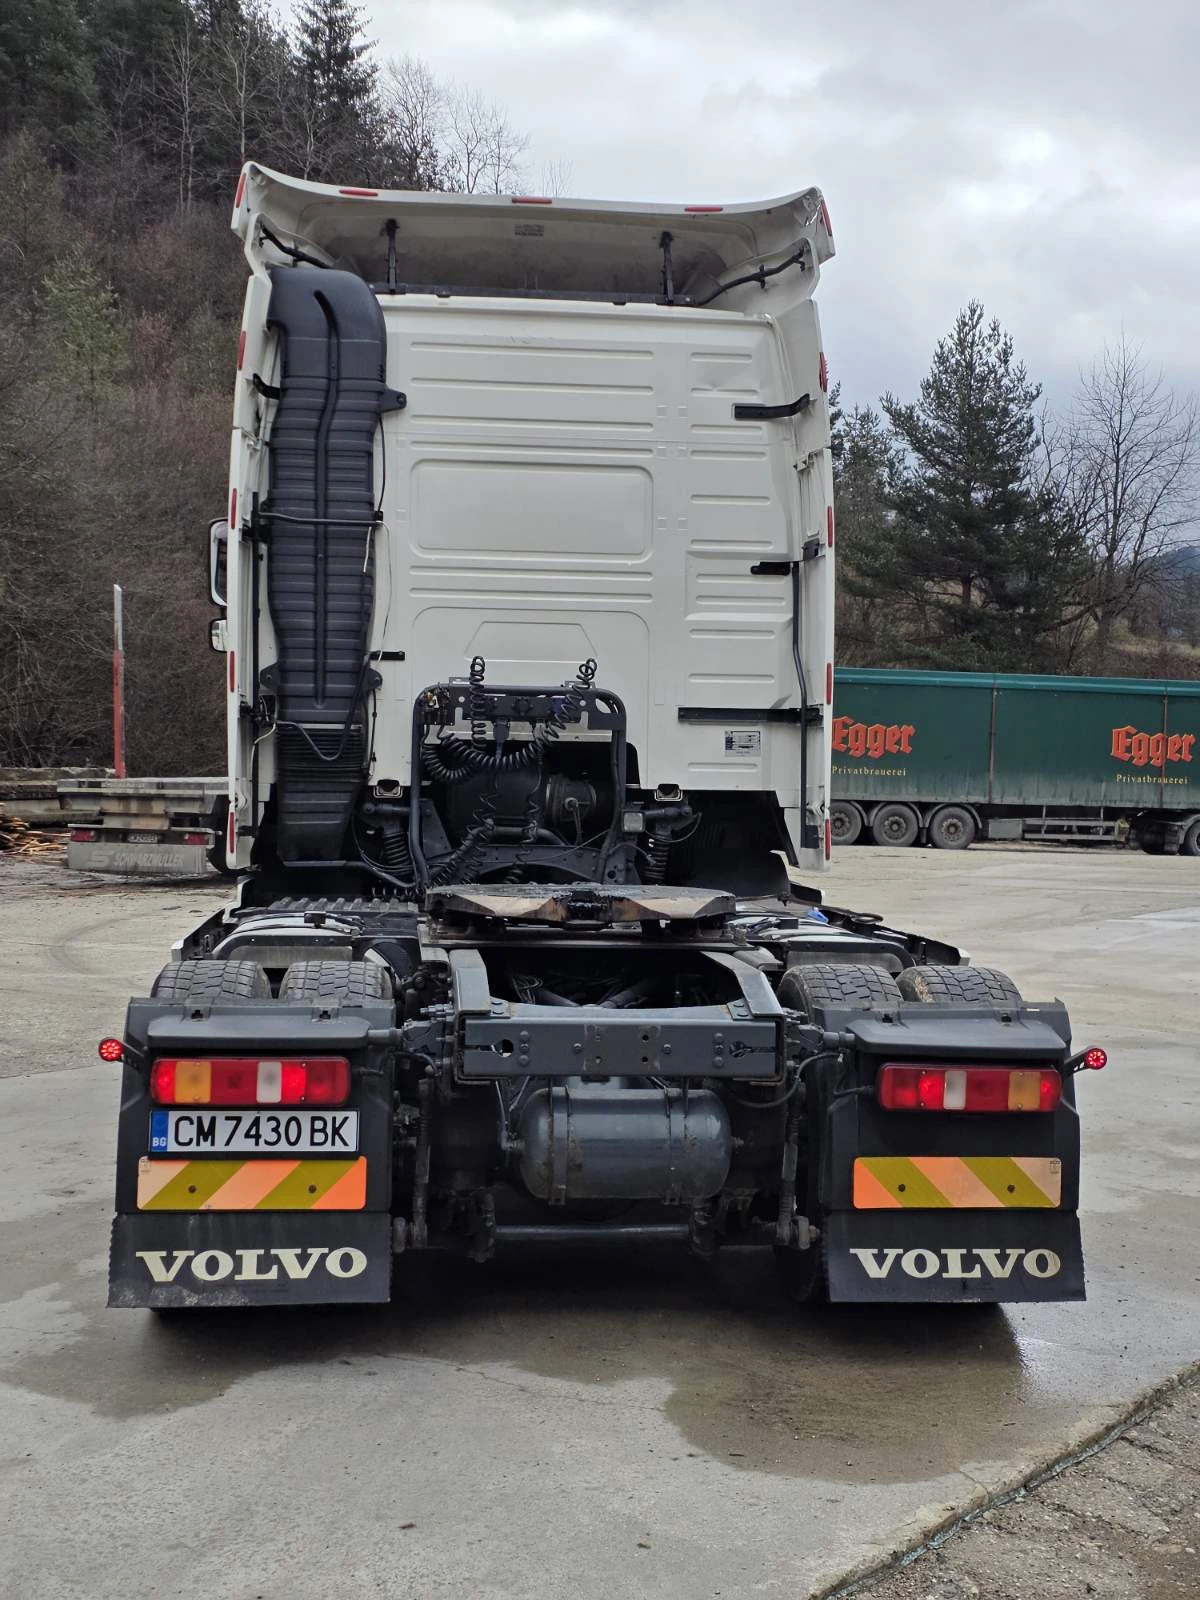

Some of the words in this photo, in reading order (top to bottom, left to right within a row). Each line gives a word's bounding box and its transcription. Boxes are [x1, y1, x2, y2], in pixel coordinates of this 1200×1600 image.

[832, 716, 916, 759] Egger
[1110, 725, 1196, 767] Egger
[832, 765, 906, 776] Privatbrauerei
[1116, 773, 1188, 784] Privatbrauerei
[152, 1137, 167, 1147] BG
[174, 1115, 217, 1147] CM
[224, 1115, 302, 1147] 7430
[310, 1115, 350, 1147] BK
[136, 1247, 367, 1282] VOLVO
[850, 1249, 1061, 1278] VOLVO
